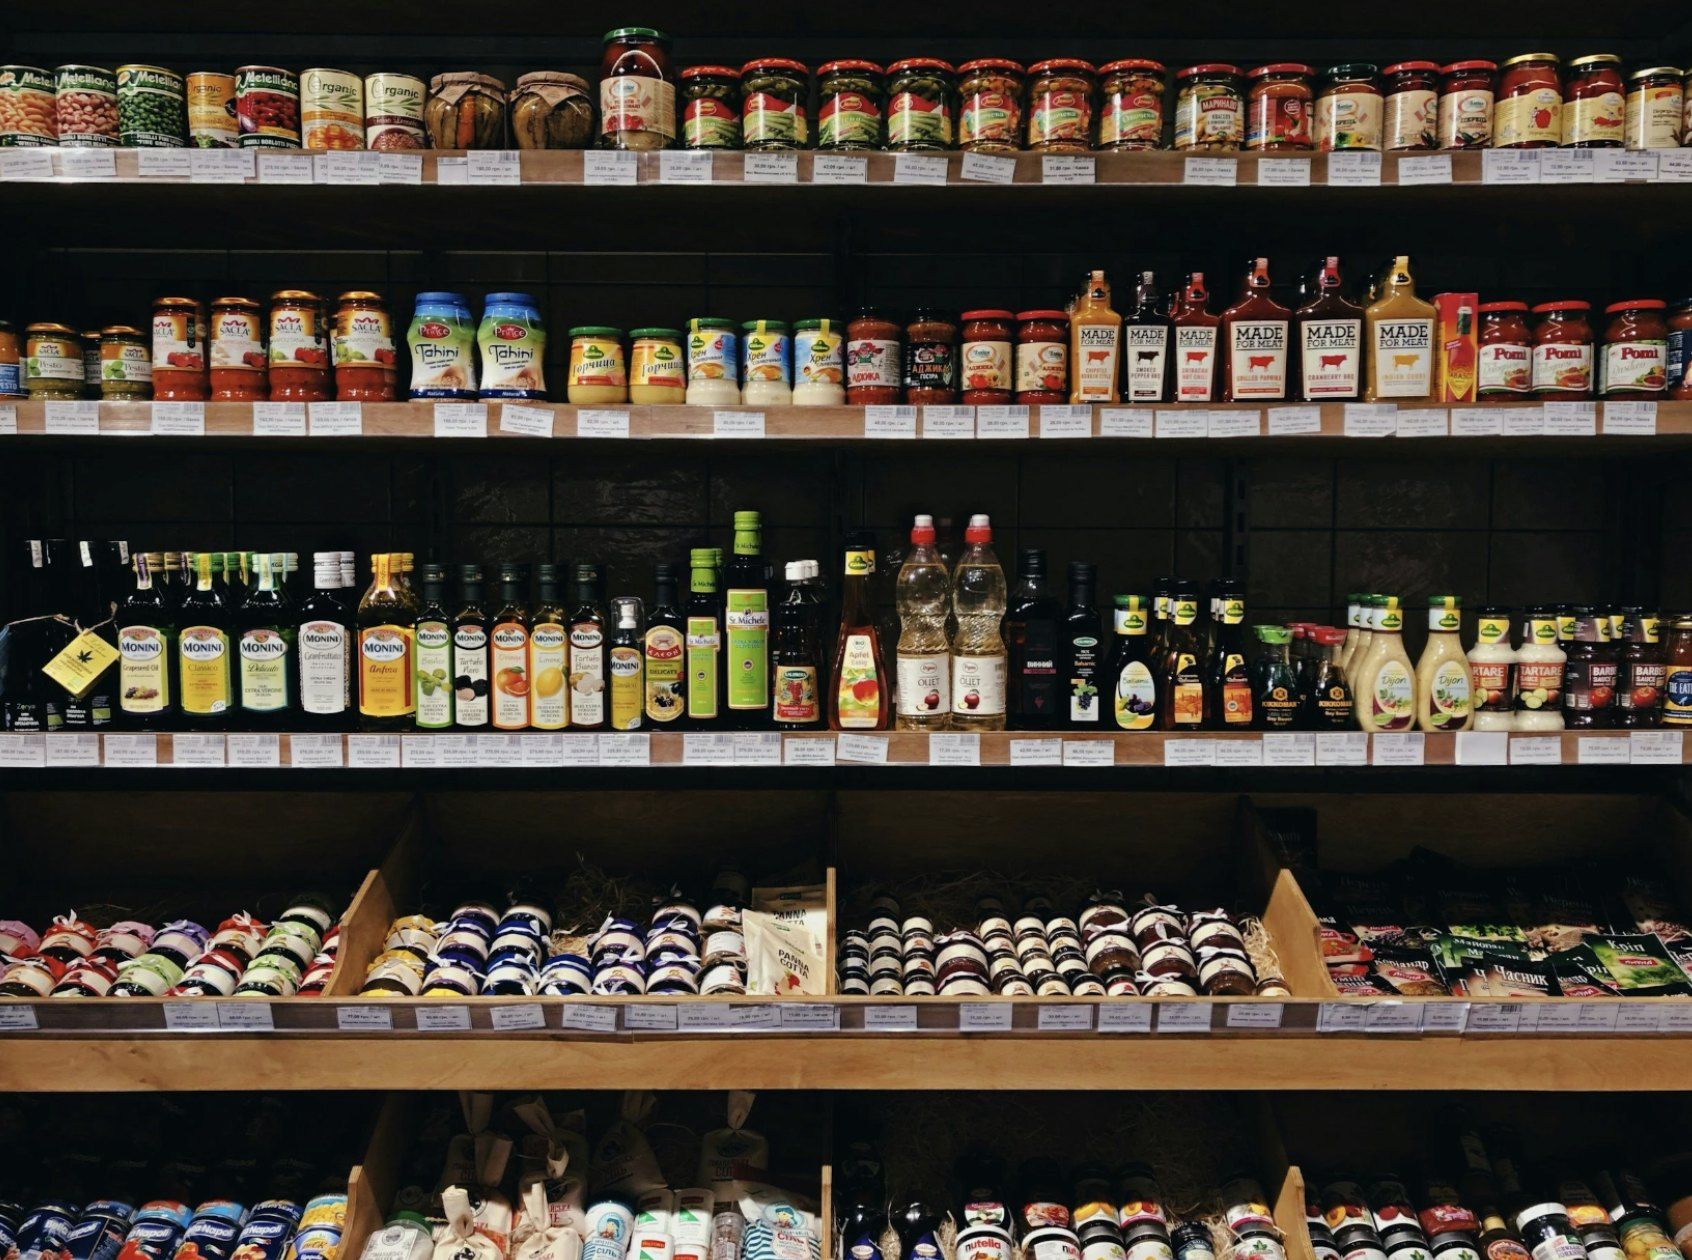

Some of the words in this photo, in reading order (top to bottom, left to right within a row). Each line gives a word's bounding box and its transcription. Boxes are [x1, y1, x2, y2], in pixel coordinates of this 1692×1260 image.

[307, 73, 358, 97] Organic
[370, 74, 420, 99] Organic
[1081, 330, 1115, 340] MADE
[1130, 330, 1164, 339] MADE
[1179, 331, 1214, 340] MADE
[1236, 327, 1283, 340] MADE
[1306, 325, 1356, 339] MADE
[1379, 325, 1428, 339] MADE
[1236, 340, 1257, 348] FOR
[1307, 339, 1328, 347] FOR
[1329, 339, 1356, 347] MEAT
[1380, 339, 1401, 347] FOR
[1401, 338, 1429, 346] MEAT
[414, 343, 460, 362] Tahini
[488, 344, 534, 363] Tahini
[746, 351, 767, 362] Хрен
[808, 351, 831, 363] Хрен
[39, 360, 62, 368] Pesto
[124, 364, 146, 372] Pesto
[572, 358, 616, 375] Горчица
[851, 372, 881, 382] АДЖИКА
[739, 615, 766, 624] Michele
[305, 635, 338, 643] MONINI
[456, 634, 485, 642] MONINI
[495, 634, 525, 642] MONINI
[121, 643, 159, 652] MONINI
[184, 643, 222, 652] MONINI
[241, 643, 283, 653] MONINI
[364, 643, 403, 653] MONINI
[850, 651, 869, 659] Apfel
[463, 666, 479, 674] Nero
[610, 661, 639, 670] MONINI
[1472, 665, 1504, 677] RTARE
[1519, 665, 1562, 677] TARTARE
[917, 677, 940, 687] ОЦЕТ
[959, 678, 981, 687] ОЦЕТ
[1381, 675, 1408, 687] Dijon
[1438, 674, 1464, 687] Dijon
[1606, 939, 1646, 952] Кріп
[778, 949, 810, 972] PANNA
[1374, 958, 1429, 971] Коріандр
[780, 958, 809, 980] COTTA
[1493, 964, 1550, 986] Часник
[137, 1226, 170, 1239] Napoli
[200, 1224, 235, 1238] Napoli
[249, 1224, 282, 1235] Napoli
[965, 1239, 1001, 1253] nutella
